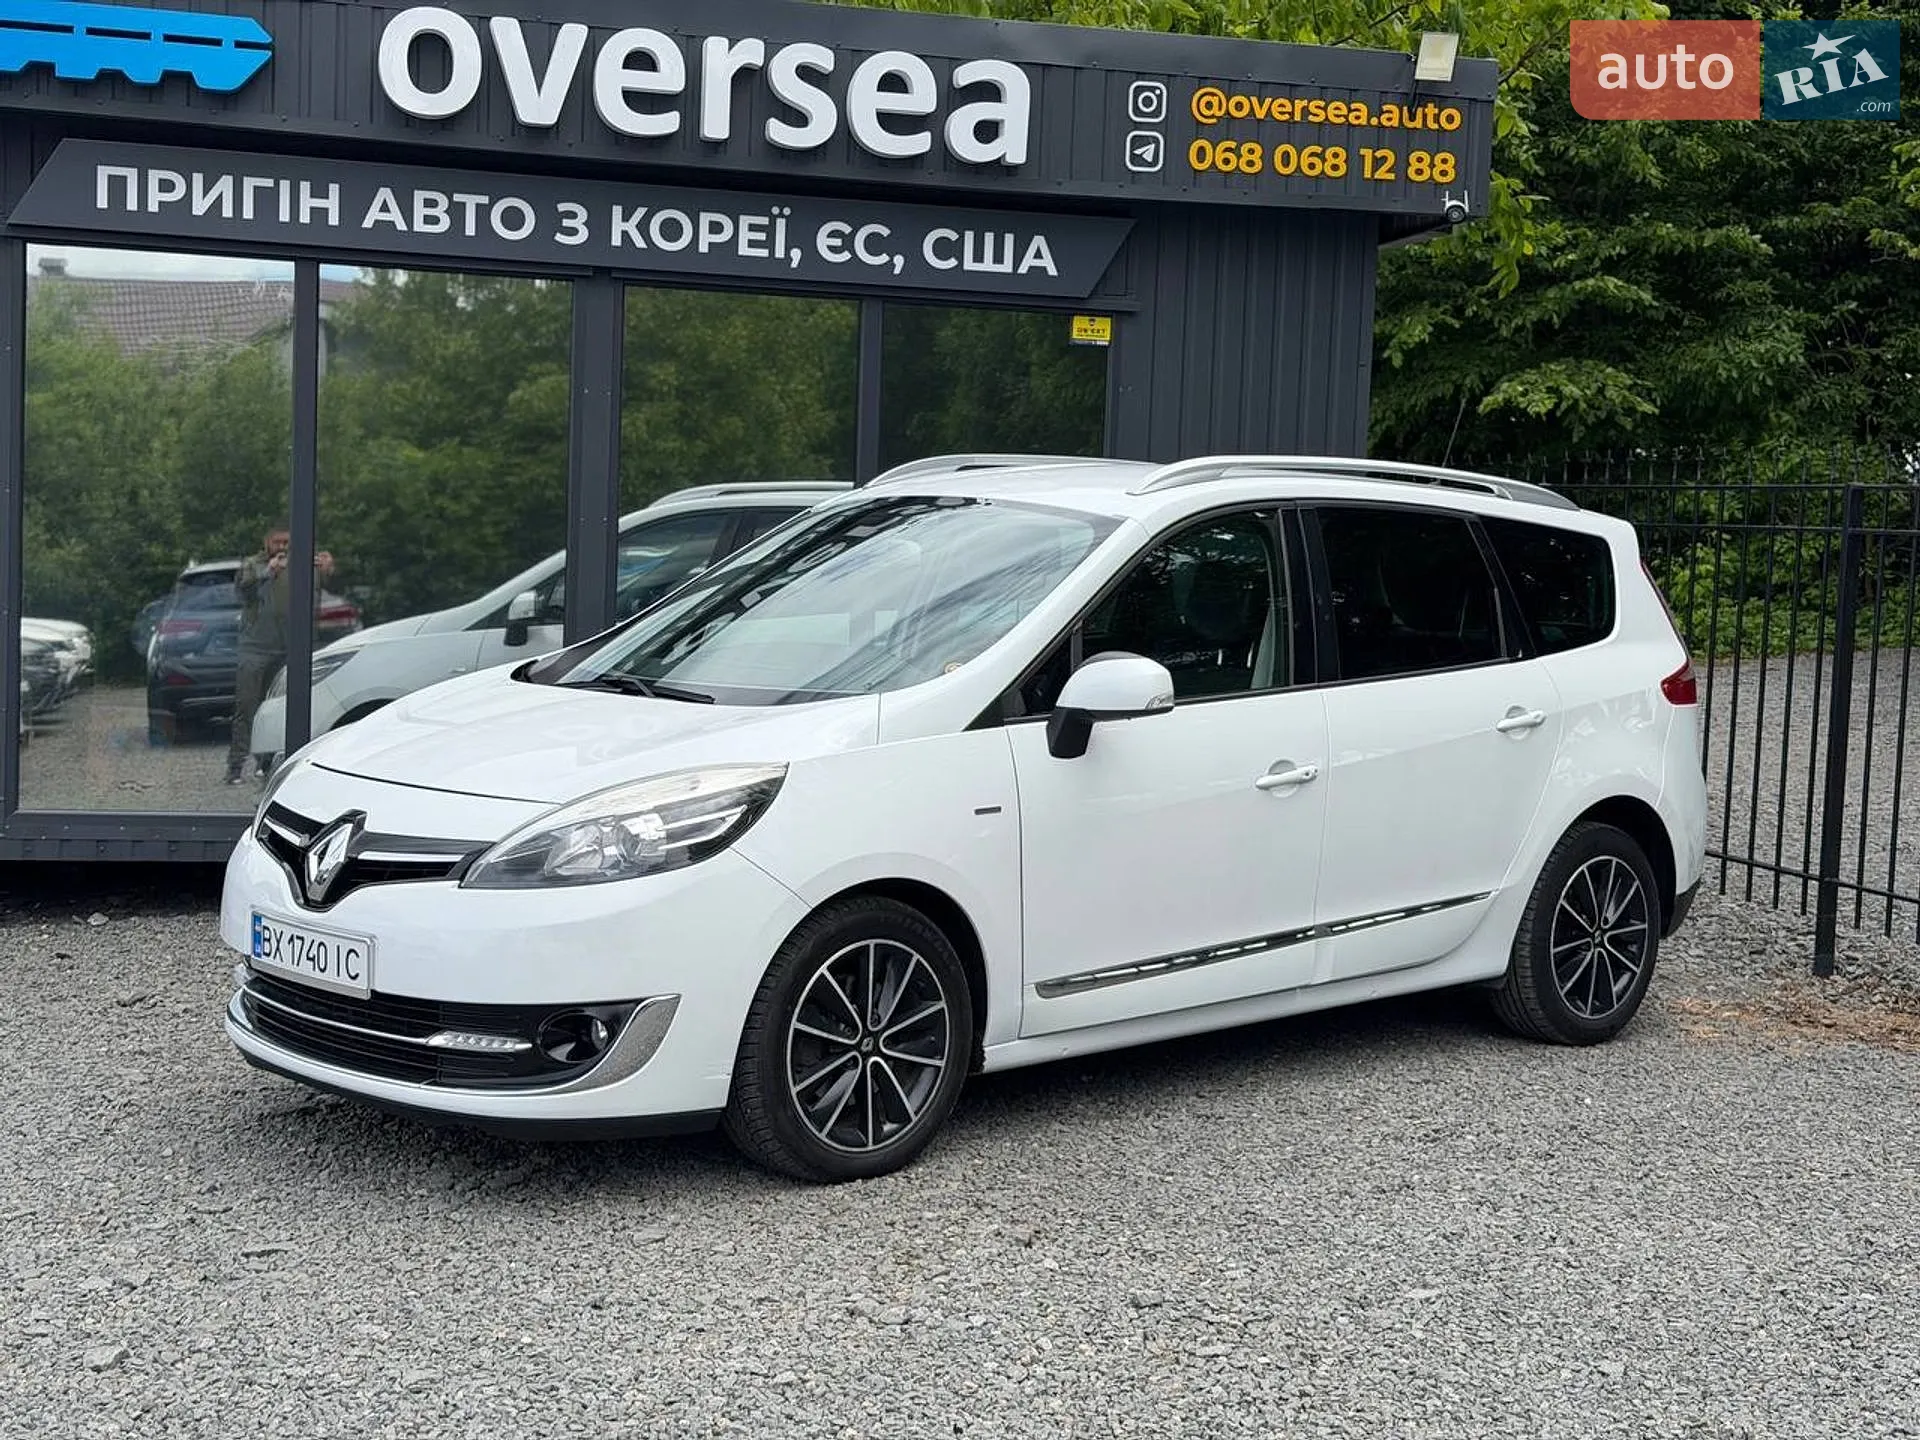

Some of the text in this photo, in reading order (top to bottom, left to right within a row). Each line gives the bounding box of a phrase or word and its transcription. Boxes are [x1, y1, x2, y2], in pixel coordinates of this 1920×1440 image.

[378, 6, 1030, 166] oversea
[1190, 86, 1462, 131] @oversea.auto
[1188, 138, 1457, 183] 068 068 12 88
[95, 164, 1058, 276] ПРИГІН АВТО З КОРЕЇ, ЄС, США
[262, 925, 360, 980] BX 1740 IC
